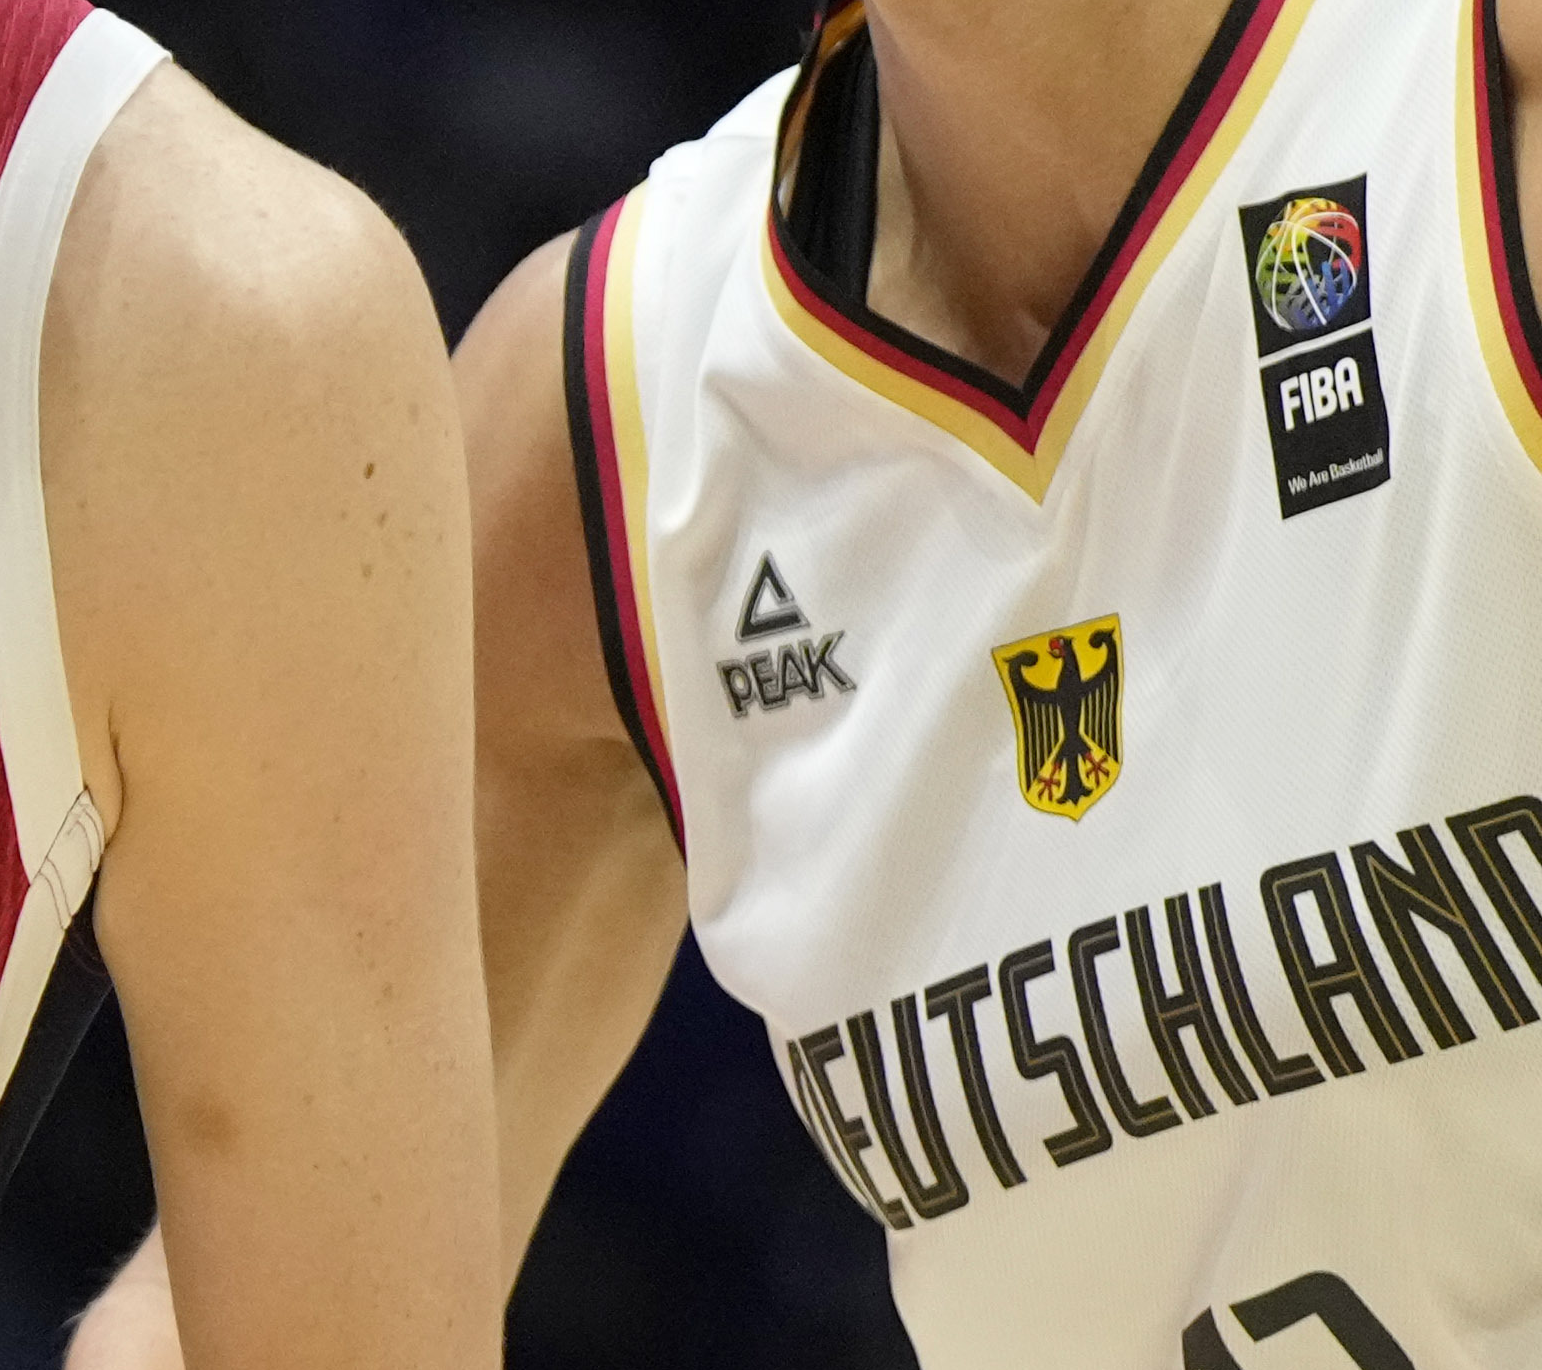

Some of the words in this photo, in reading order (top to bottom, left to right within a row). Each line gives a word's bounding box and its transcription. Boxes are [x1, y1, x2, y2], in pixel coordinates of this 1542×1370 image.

[1279, 356, 1365, 432] FIBA
[1287, 476, 1307, 496] We
[1309, 470, 1330, 488] Are
[1329, 447, 1384, 480] Basketball
[715, 629, 858, 720] PEAK
